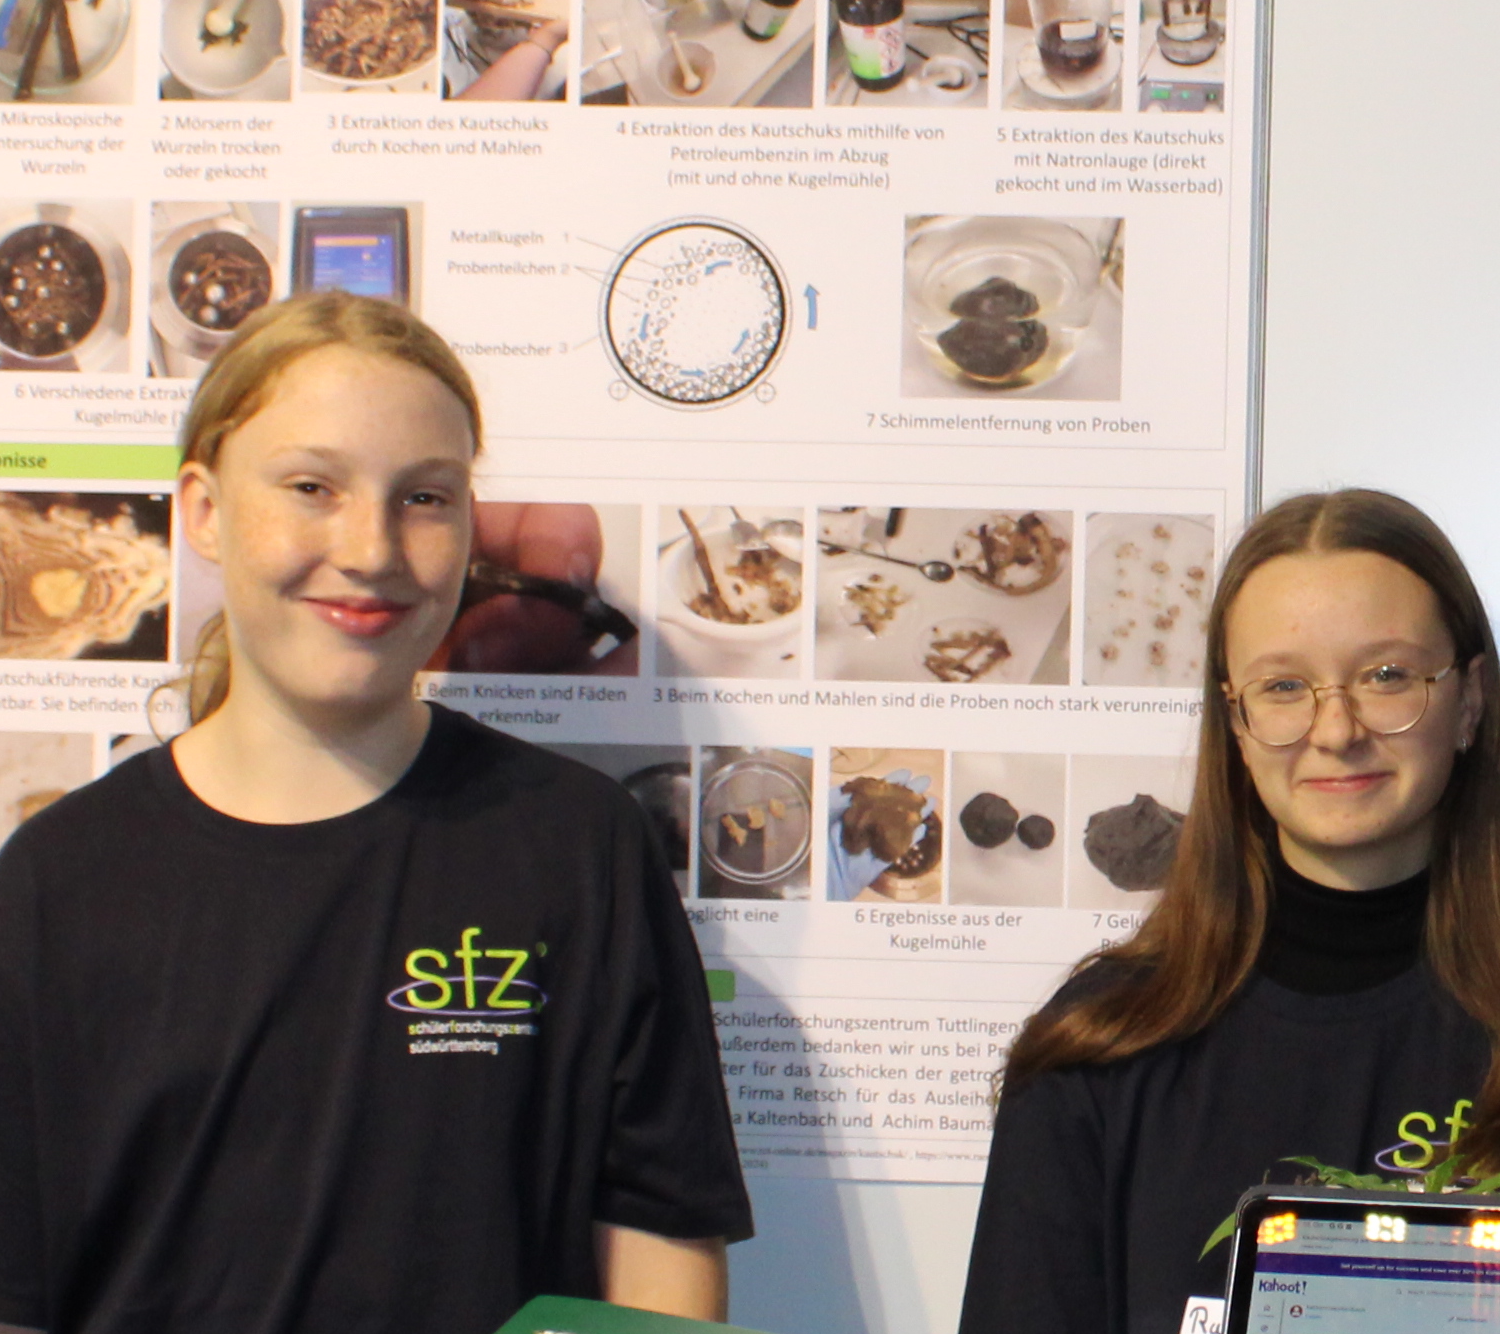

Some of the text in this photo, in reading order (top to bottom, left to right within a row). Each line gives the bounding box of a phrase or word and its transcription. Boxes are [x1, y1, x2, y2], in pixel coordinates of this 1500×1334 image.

[997, 128, 1224, 145] 5 Extraktion des Kautschuks
[1015, 152, 1206, 172] mit Natronlauge (direkt
[995, 176, 1223, 196] gekocht und im Wasserbad)
[867, 413, 1151, 434] 7 Schimmelentfernung von Proben
[653, 688, 663, 702] 3
[668, 687, 708, 703] Beim
[714, 689, 773, 704] Kochen
[779, 691, 810, 705] und
[815, 691, 877, 707] Mahlen
[882, 693, 915, 708] sind
[920, 693, 945, 708] die
[951, 694, 1009, 709] Proben
[1014, 696, 1054, 710] noch
[1060, 697, 1099, 712] stark
[855, 908, 1022, 927] 6 Ergebnisse aus der
[890, 934, 986, 952] Kugelmühle
[408, 1020, 540, 1037] schülerforschungszent
[409, 1039, 499, 1055] südwürttemberg
[748, 1111, 836, 1126] Kaltenbach
[843, 1115, 872, 1127] und
[883, 1115, 933, 1127] Achim
[1258, 1279, 1308, 1295] Kahoot!
